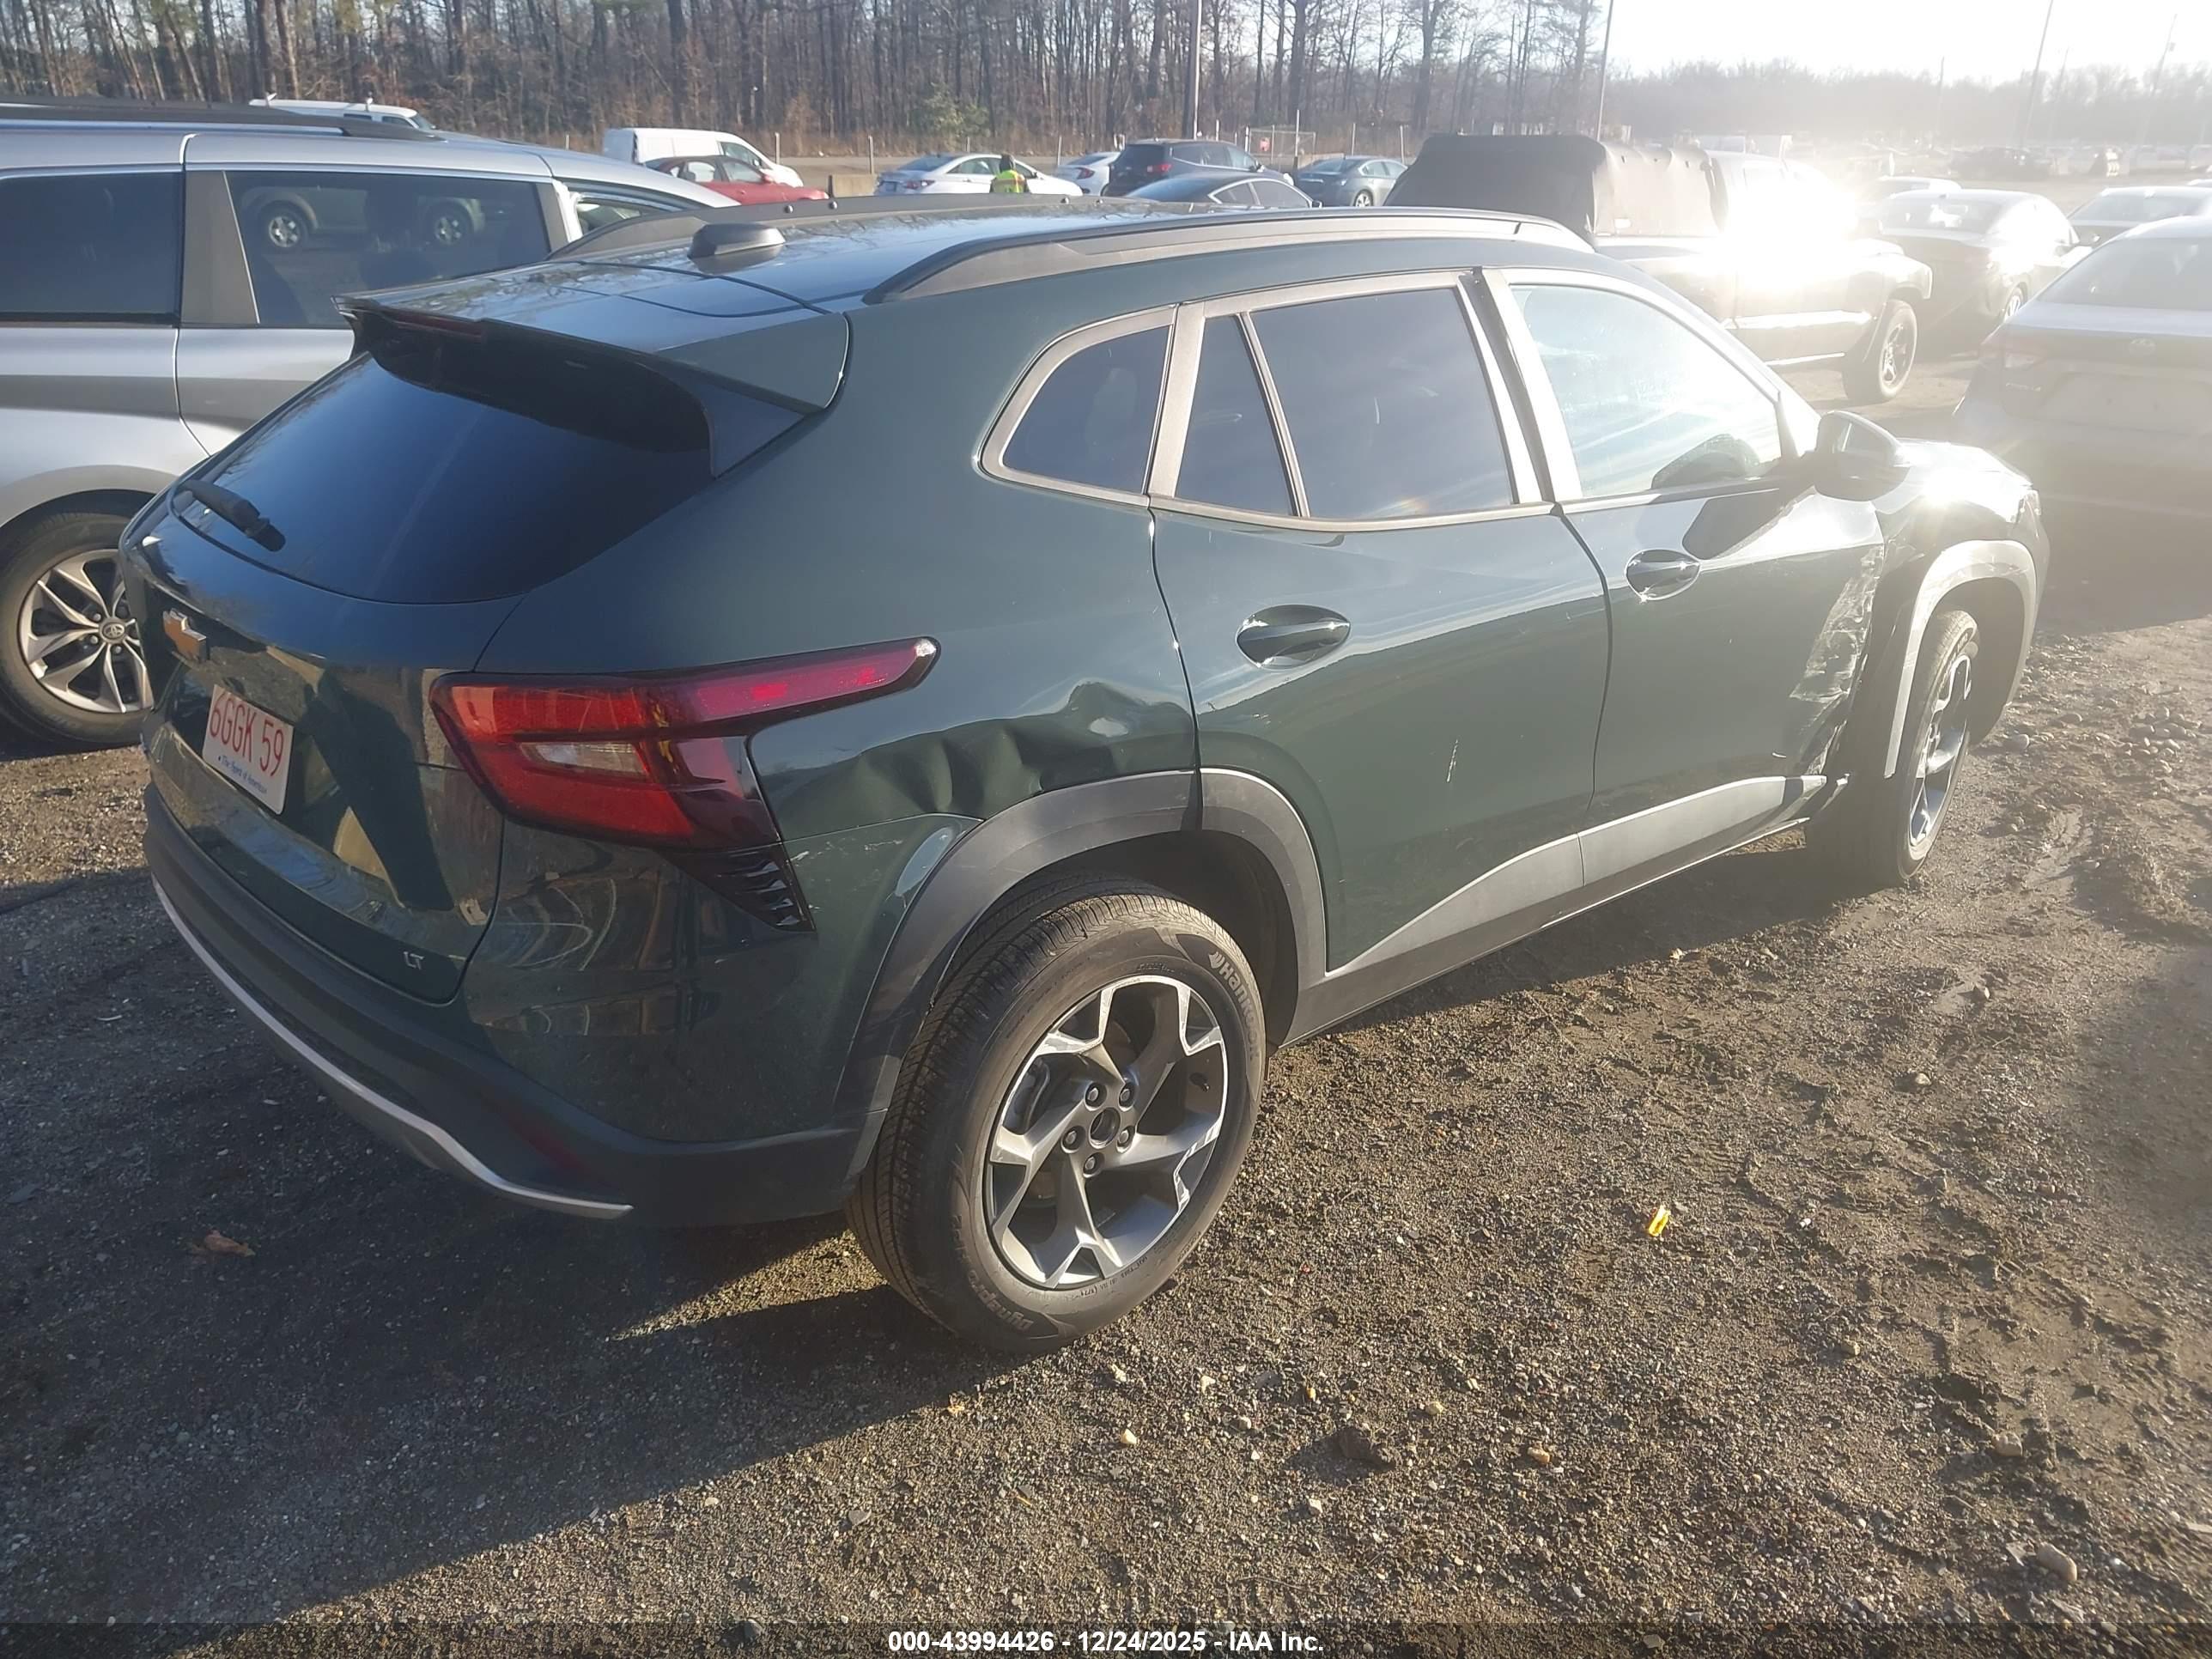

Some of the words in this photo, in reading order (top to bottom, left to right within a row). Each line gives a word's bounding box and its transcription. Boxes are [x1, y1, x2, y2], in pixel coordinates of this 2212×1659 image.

[210, 690, 257, 763] 6GGK
[259, 718, 284, 777] 59
[403, 951, 426, 970] LT
[1218, 961, 1260, 1061] Hankook
